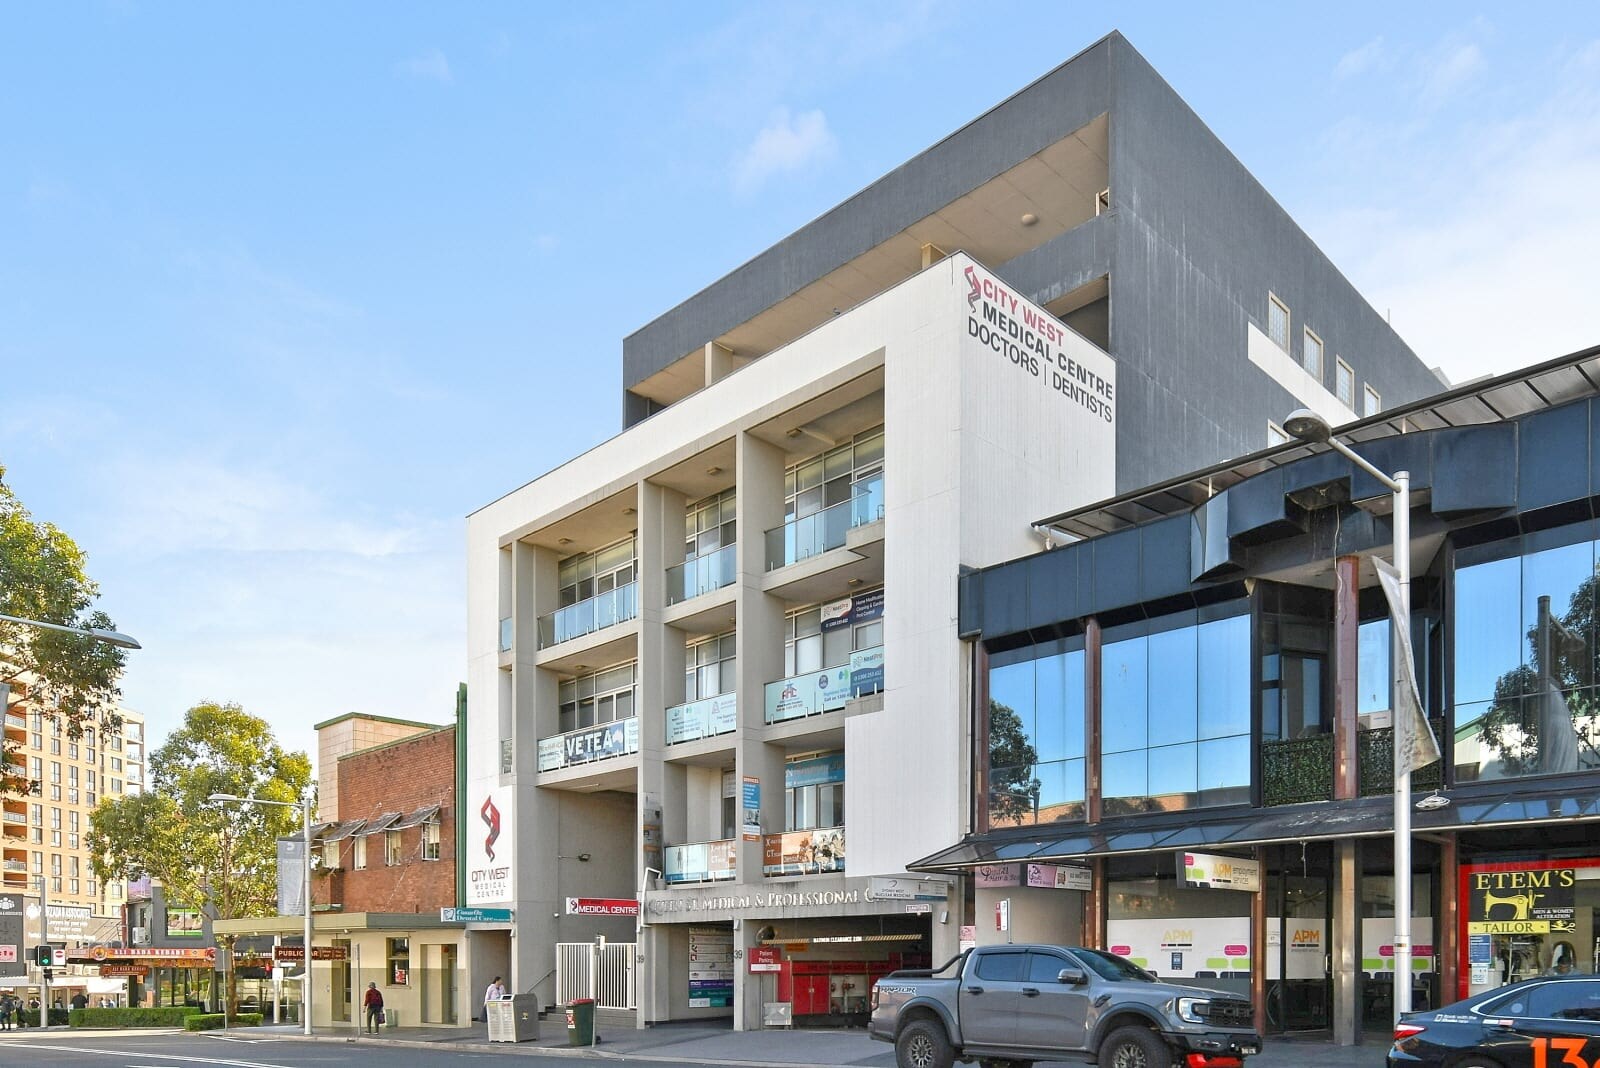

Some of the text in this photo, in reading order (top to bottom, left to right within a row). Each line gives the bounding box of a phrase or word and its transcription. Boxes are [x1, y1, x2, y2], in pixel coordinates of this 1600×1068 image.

[983, 278, 1064, 347] CITY WEST
[983, 301, 1113, 401] MEDICAL CENTRE
[968, 316, 1112, 423] DOCTORS DENTISTS
[472, 867, 510, 882] CITY WEST
[1214, 863, 1232, 878] APM
[475, 882, 506, 890] MEDICAL
[1476, 869, 1574, 890] ETEM'S
[477, 889, 504, 898] CENTRE
[702, 895, 752, 911] MEDICAL
[754, 892, 765, 908] &
[767, 889, 858, 907] PROFESSIONAL
[578, 905, 638, 914] MEDICAL CENTRE
[1483, 922, 1533, 933] TAILOR
[1162, 929, 1193, 942] APM
[1292, 929, 1320, 943] APM
[734, 950, 743, 959] 39
[1530, 1037, 1600, 1068] 13
